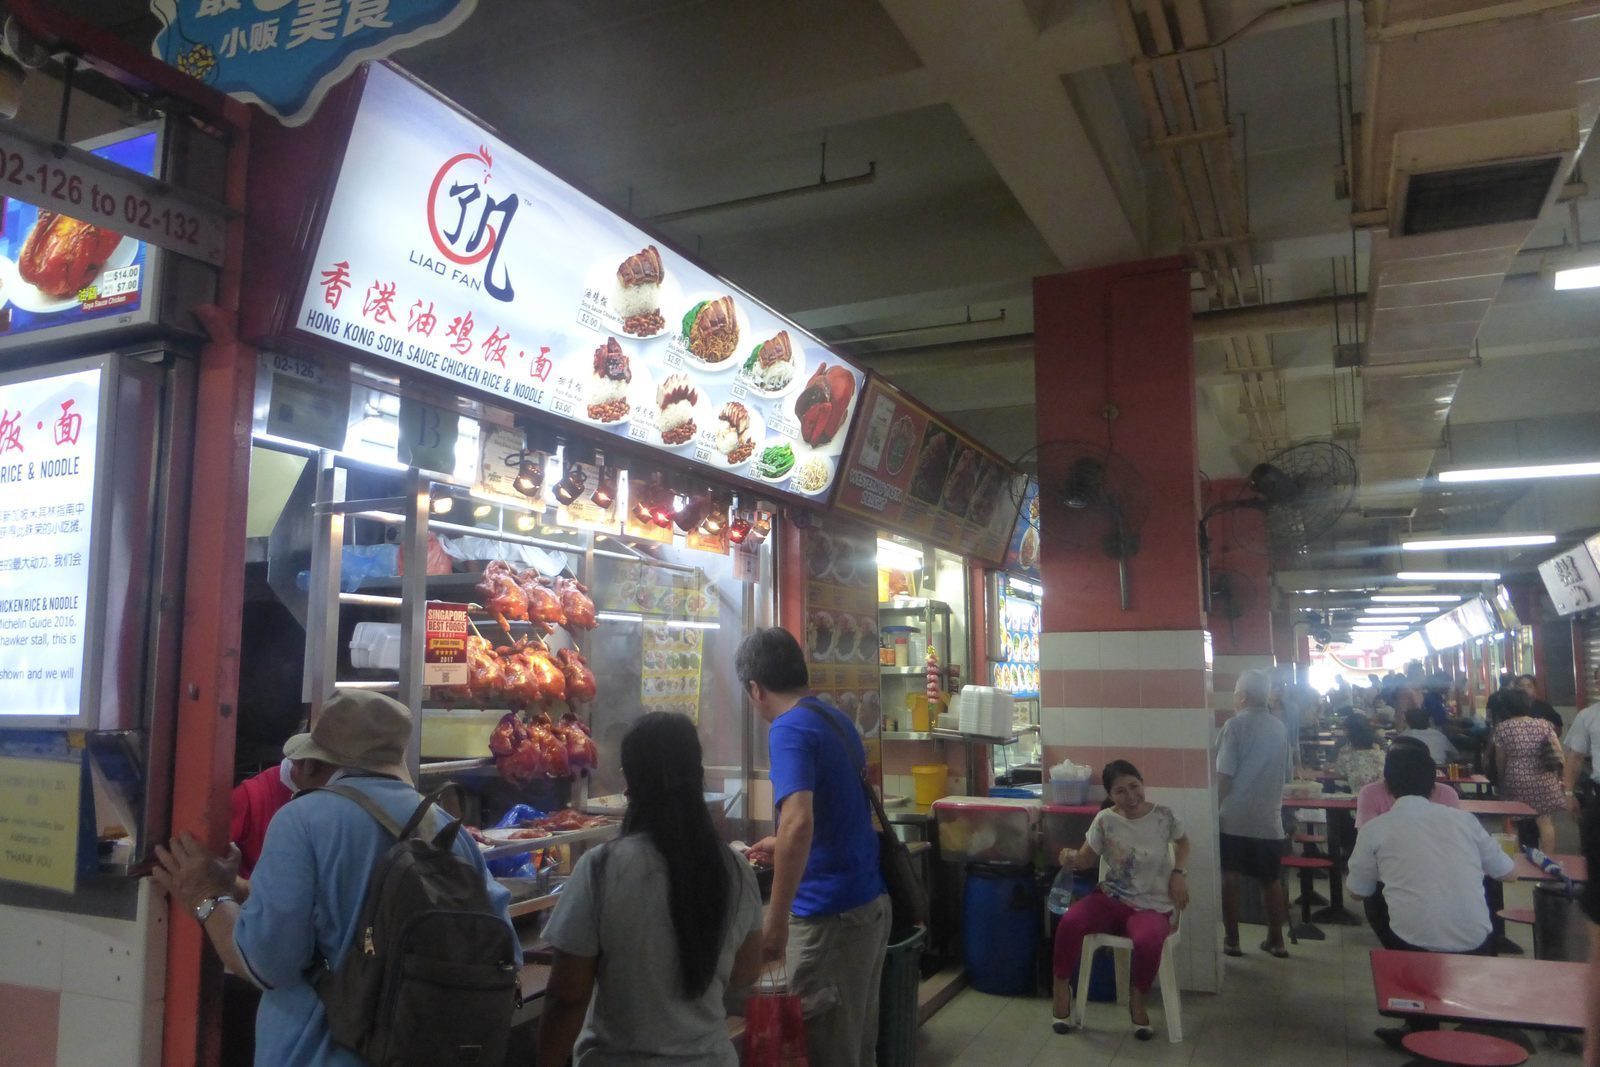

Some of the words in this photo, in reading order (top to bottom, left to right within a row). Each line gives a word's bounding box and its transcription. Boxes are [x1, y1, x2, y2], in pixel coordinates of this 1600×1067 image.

[219, 18, 279, 58] 小贩
[92, 184, 115, 216] to
[124, 194, 200, 245] 02-132
[113, 267, 139, 281] $14.00
[409, 250, 447, 276] LIAO
[452, 268, 482, 292] FAN
[117, 280, 137, 292] $7.00
[581, 313, 599, 328] $2.00
[306, 308, 339, 335] HONG
[343, 322, 374, 347] KONG
[376, 333, 404, 358] SOYA
[406, 344, 440, 370] SAUCE
[440, 356, 481, 384] CHICKEN
[480, 370, 503, 392] RICE
[504, 378, 511, 393] &
[513, 381, 545, 405] NOODLE
[273, 355, 315, 379] 02-126
[555, 400, 572, 413] $3.00
[418, 407, 441, 450] B
[631, 427, 647, 439] $2.50
[0, 464, 23, 483] RICE
[28, 462, 35, 480] &
[40, 456, 80, 478] NOODLE
[24, 597, 41, 612] RICE
[42, 596, 48, 611] &
[49, 595, 79, 610] NOODLE
[29, 616, 52, 629] Guide
[54, 614, 77, 628] 2016.
[427, 609, 467, 622] SINGAPORE
[428, 621, 444, 631] BEST
[445, 622, 465, 632] FOODS
[0, 634, 28, 647] hawker
[31, 632, 50, 647] stall,
[53, 632, 67, 645] this
[69, 633, 77, 645] is
[27, 666, 43, 680] and
[45, 669, 58, 680] we
[60, 666, 74, 680] will
